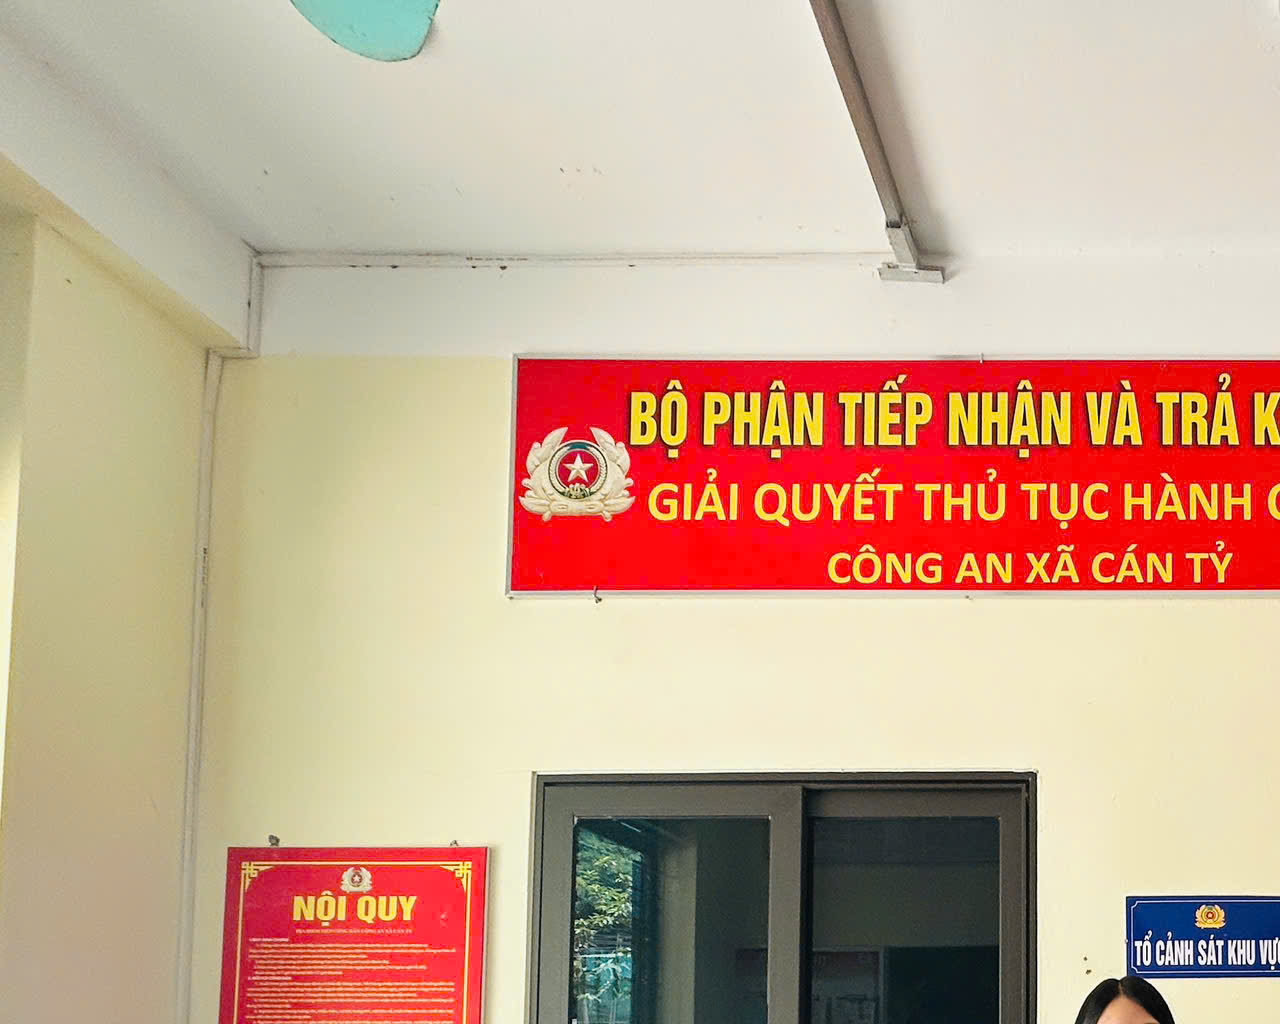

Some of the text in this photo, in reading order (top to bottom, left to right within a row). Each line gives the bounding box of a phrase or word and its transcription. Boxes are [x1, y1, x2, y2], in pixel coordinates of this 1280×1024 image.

[629, 380, 688, 459] BỘ
[703, 380, 824, 459] PHẬN
[838, 374, 934, 447] TIẾP
[948, 380, 1071, 459] NHẬN
[1085, 380, 1142, 447] VÀ
[1155, 373, 1239, 447] TRẢ
[648, 468, 739, 521] GIẢI
[753, 468, 903, 527] QUYẾT
[915, 468, 1007, 521] THỦ
[1020, 482, 1109, 530] TỤC
[1124, 473, 1251, 521] HÀNH
[827, 540, 1233, 584] CÔNG AN XÃ CÁN TỶ
[292, 890, 417, 927] NỘI QUY
[1134, 930, 1153, 966] TỔ
[1155, 931, 1194, 966] CẢNH
[1197, 934, 1224, 966] SÁT
[1227, 940, 1256, 966] KHU
